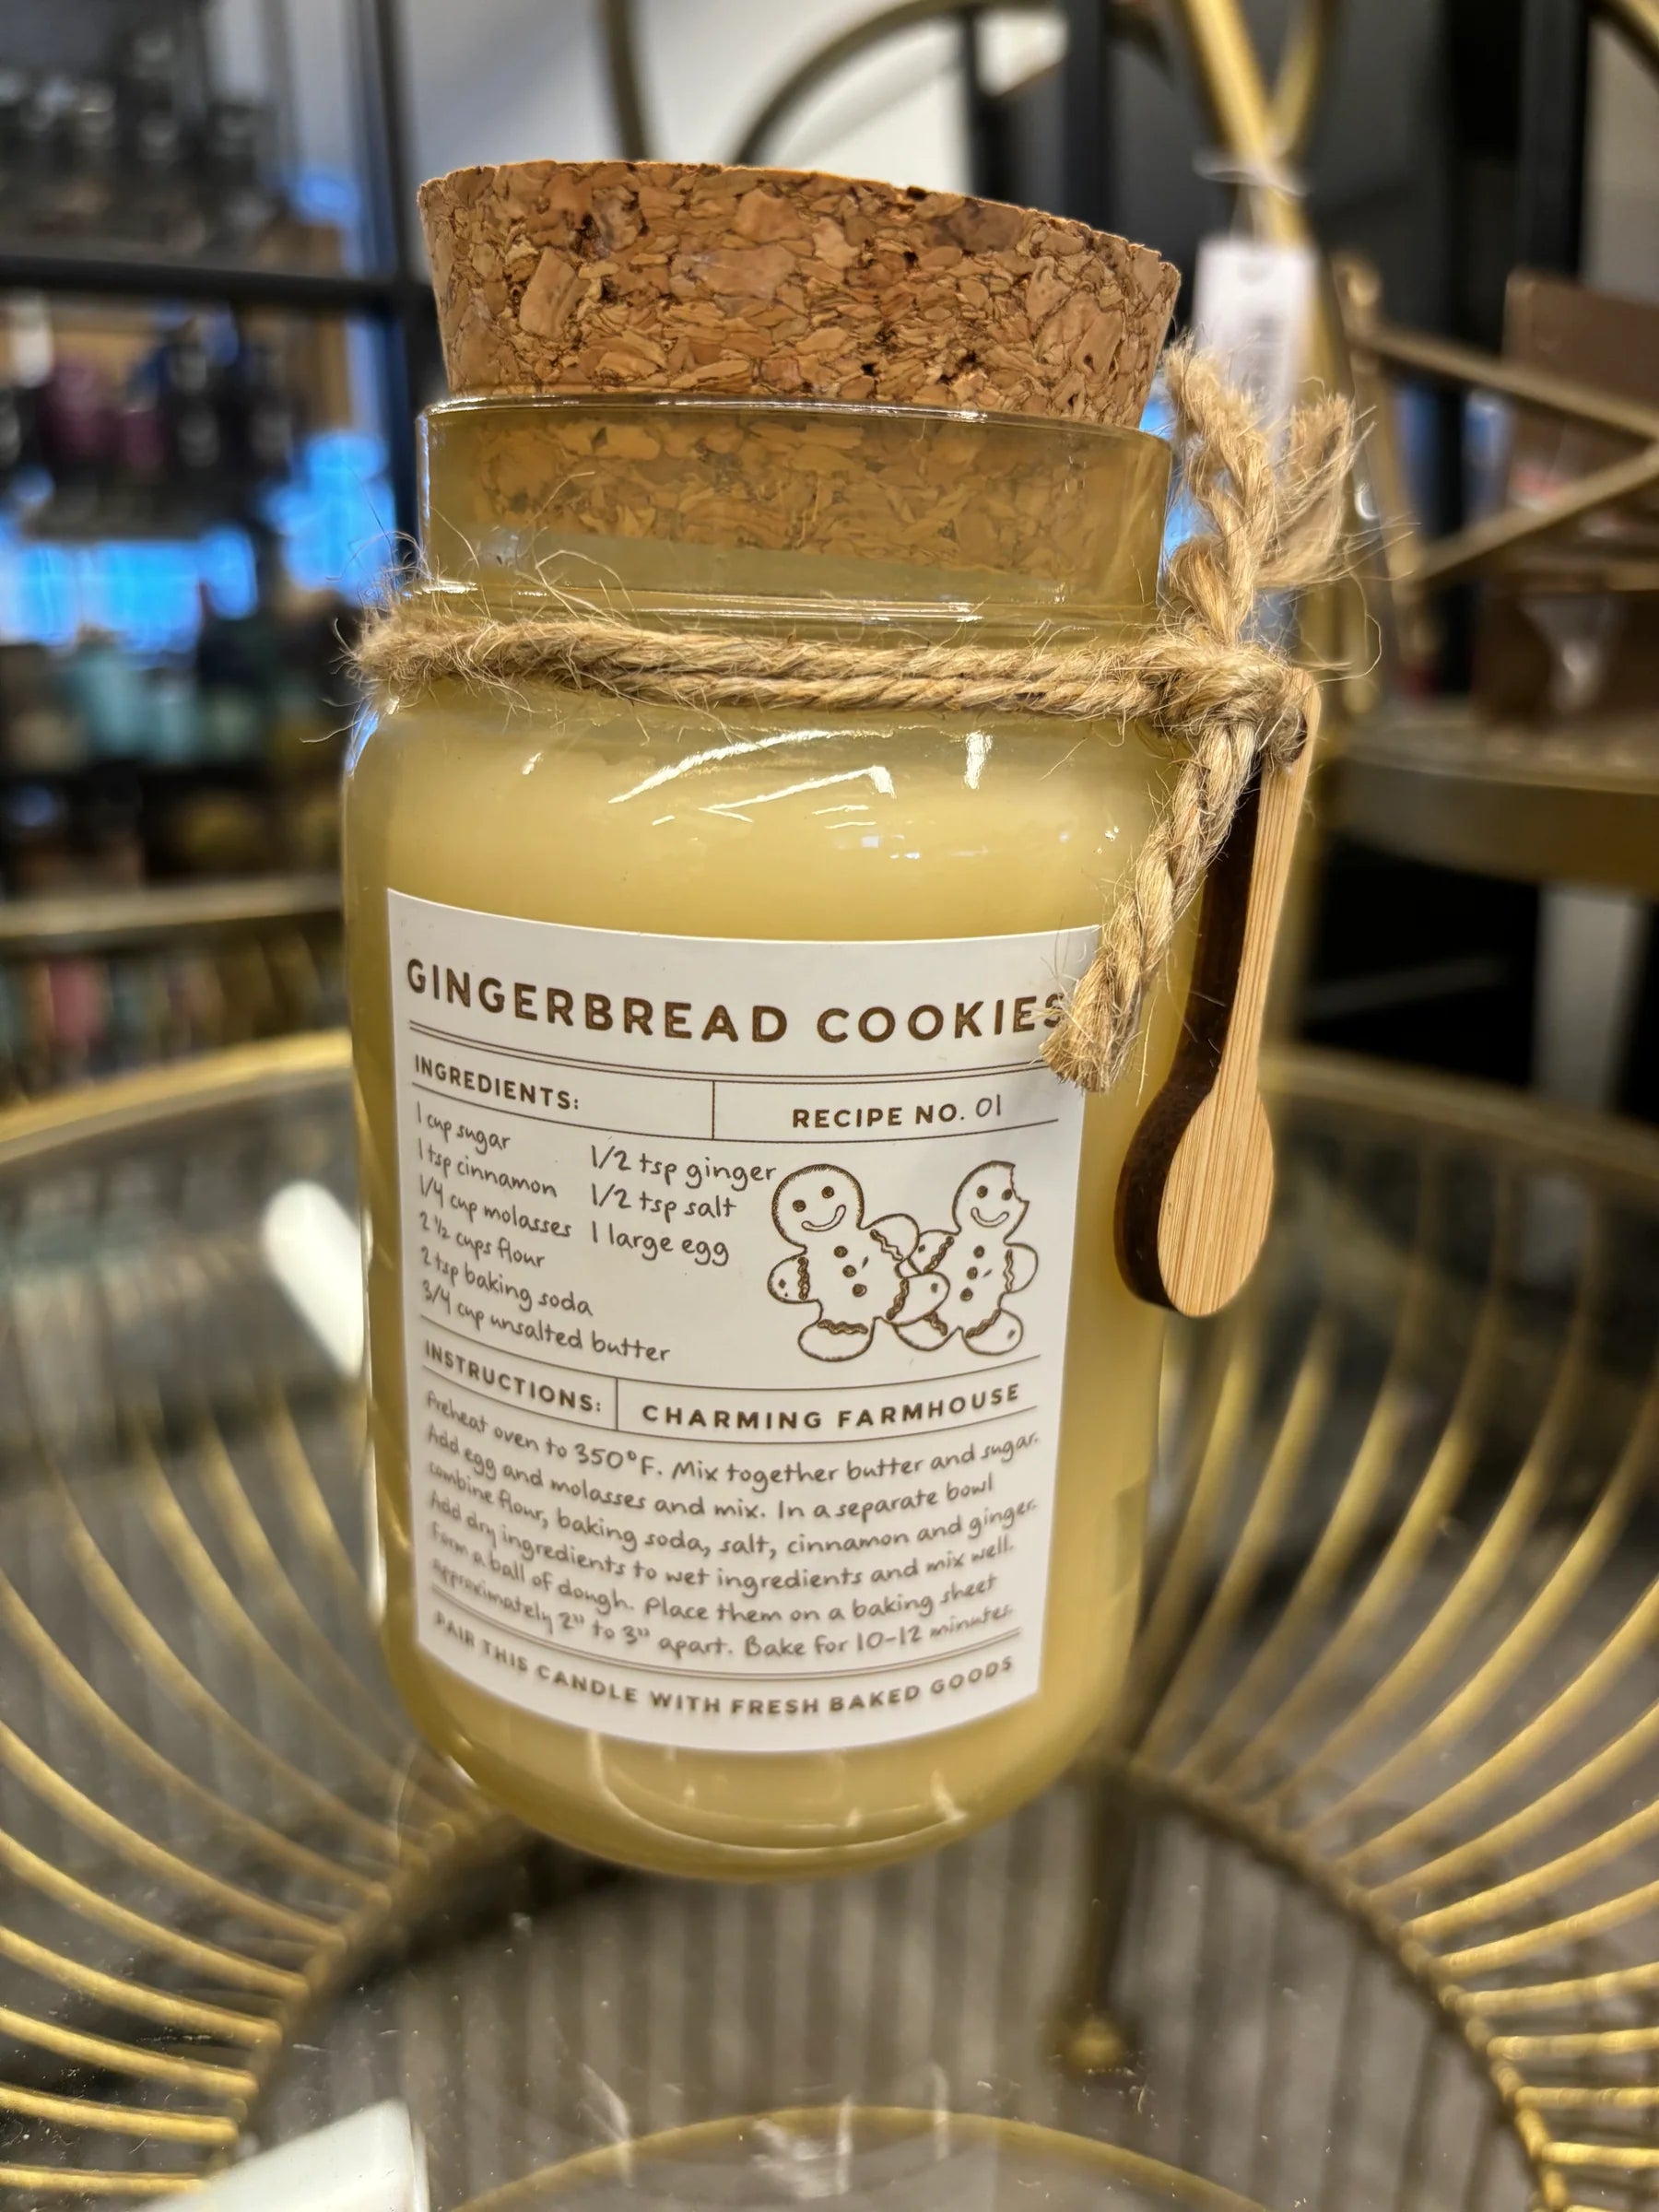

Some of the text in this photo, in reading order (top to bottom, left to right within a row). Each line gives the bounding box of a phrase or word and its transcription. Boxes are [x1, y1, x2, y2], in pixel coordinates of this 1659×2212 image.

[407, 959, 1065, 1043] GINGERBREAD COOKIES
[415, 1053, 579, 1110] INGREDIENTS:
[427, 1113, 452, 1143] cup
[456, 1124, 511, 1155] sugar
[793, 1107, 902, 1129] RECIPE
[915, 1103, 965, 1124] NO.
[428, 1144, 452, 1179] tsp
[456, 1156, 558, 1198] cinnamon
[590, 1145, 777, 1192] 1/2 tsp ginger
[419, 1174, 572, 1237] 1/4 cup molasses
[591, 1183, 737, 1224] 1/2 tsp salt
[419, 1210, 430, 1231] 2
[455, 1231, 492, 1261] cups
[498, 1237, 546, 1268] flour
[608, 1222, 674, 1261] large
[681, 1239, 730, 1267] egg
[420, 1246, 594, 1316] 2 tsp baking soda
[422, 1279, 671, 1361] 3/4 cup unsalted butter
[425, 1339, 602, 1412] INSTRUCTIONS:
[642, 1382, 1019, 1430] CHARMING FARMHOUSE
[427, 1390, 488, 1434] Preheat
[493, 1426, 539, 1452] oven
[546, 1437, 568, 1458] to
[671, 1459, 719, 1482] Mix
[726, 1461, 840, 1494] together
[846, 1456, 924, 1482] butter
[929, 1442, 976, 1470] and
[980, 1430, 1040, 1464] sugar.
[428, 1424, 994, 1524] Add egg and molasses and mix. In a separate bowl
[429, 1460, 1038, 1560] combine flour, baking soda, salt, cinnamon and ginger.
[430, 1489, 1016, 1599] Add dry ingredients to wet ingredients and mix well.
[473, 1550, 486, 1566] a
[488, 1549, 526, 1583] ball
[531, 1571, 554, 1592] of
[558, 1578, 634, 1616] dough.
[716, 1601, 783, 1624] them
[789, 1606, 821, 1622] on
[829, 1606, 847, 1620] a
[851, 1594, 935, 1618] baking
[939, 1573, 999, 1605] sheet
[434, 1610, 1014, 1716] PAIR THIS CANDLE WITH FRESH BAKED GOODS
[591, 1619, 616, 1640] to
[657, 1635, 735, 1660] apart.
[744, 1634, 806, 1657] Bake
[814, 1633, 850, 1656] for
[855, 1624, 923, 1652] 10-12
